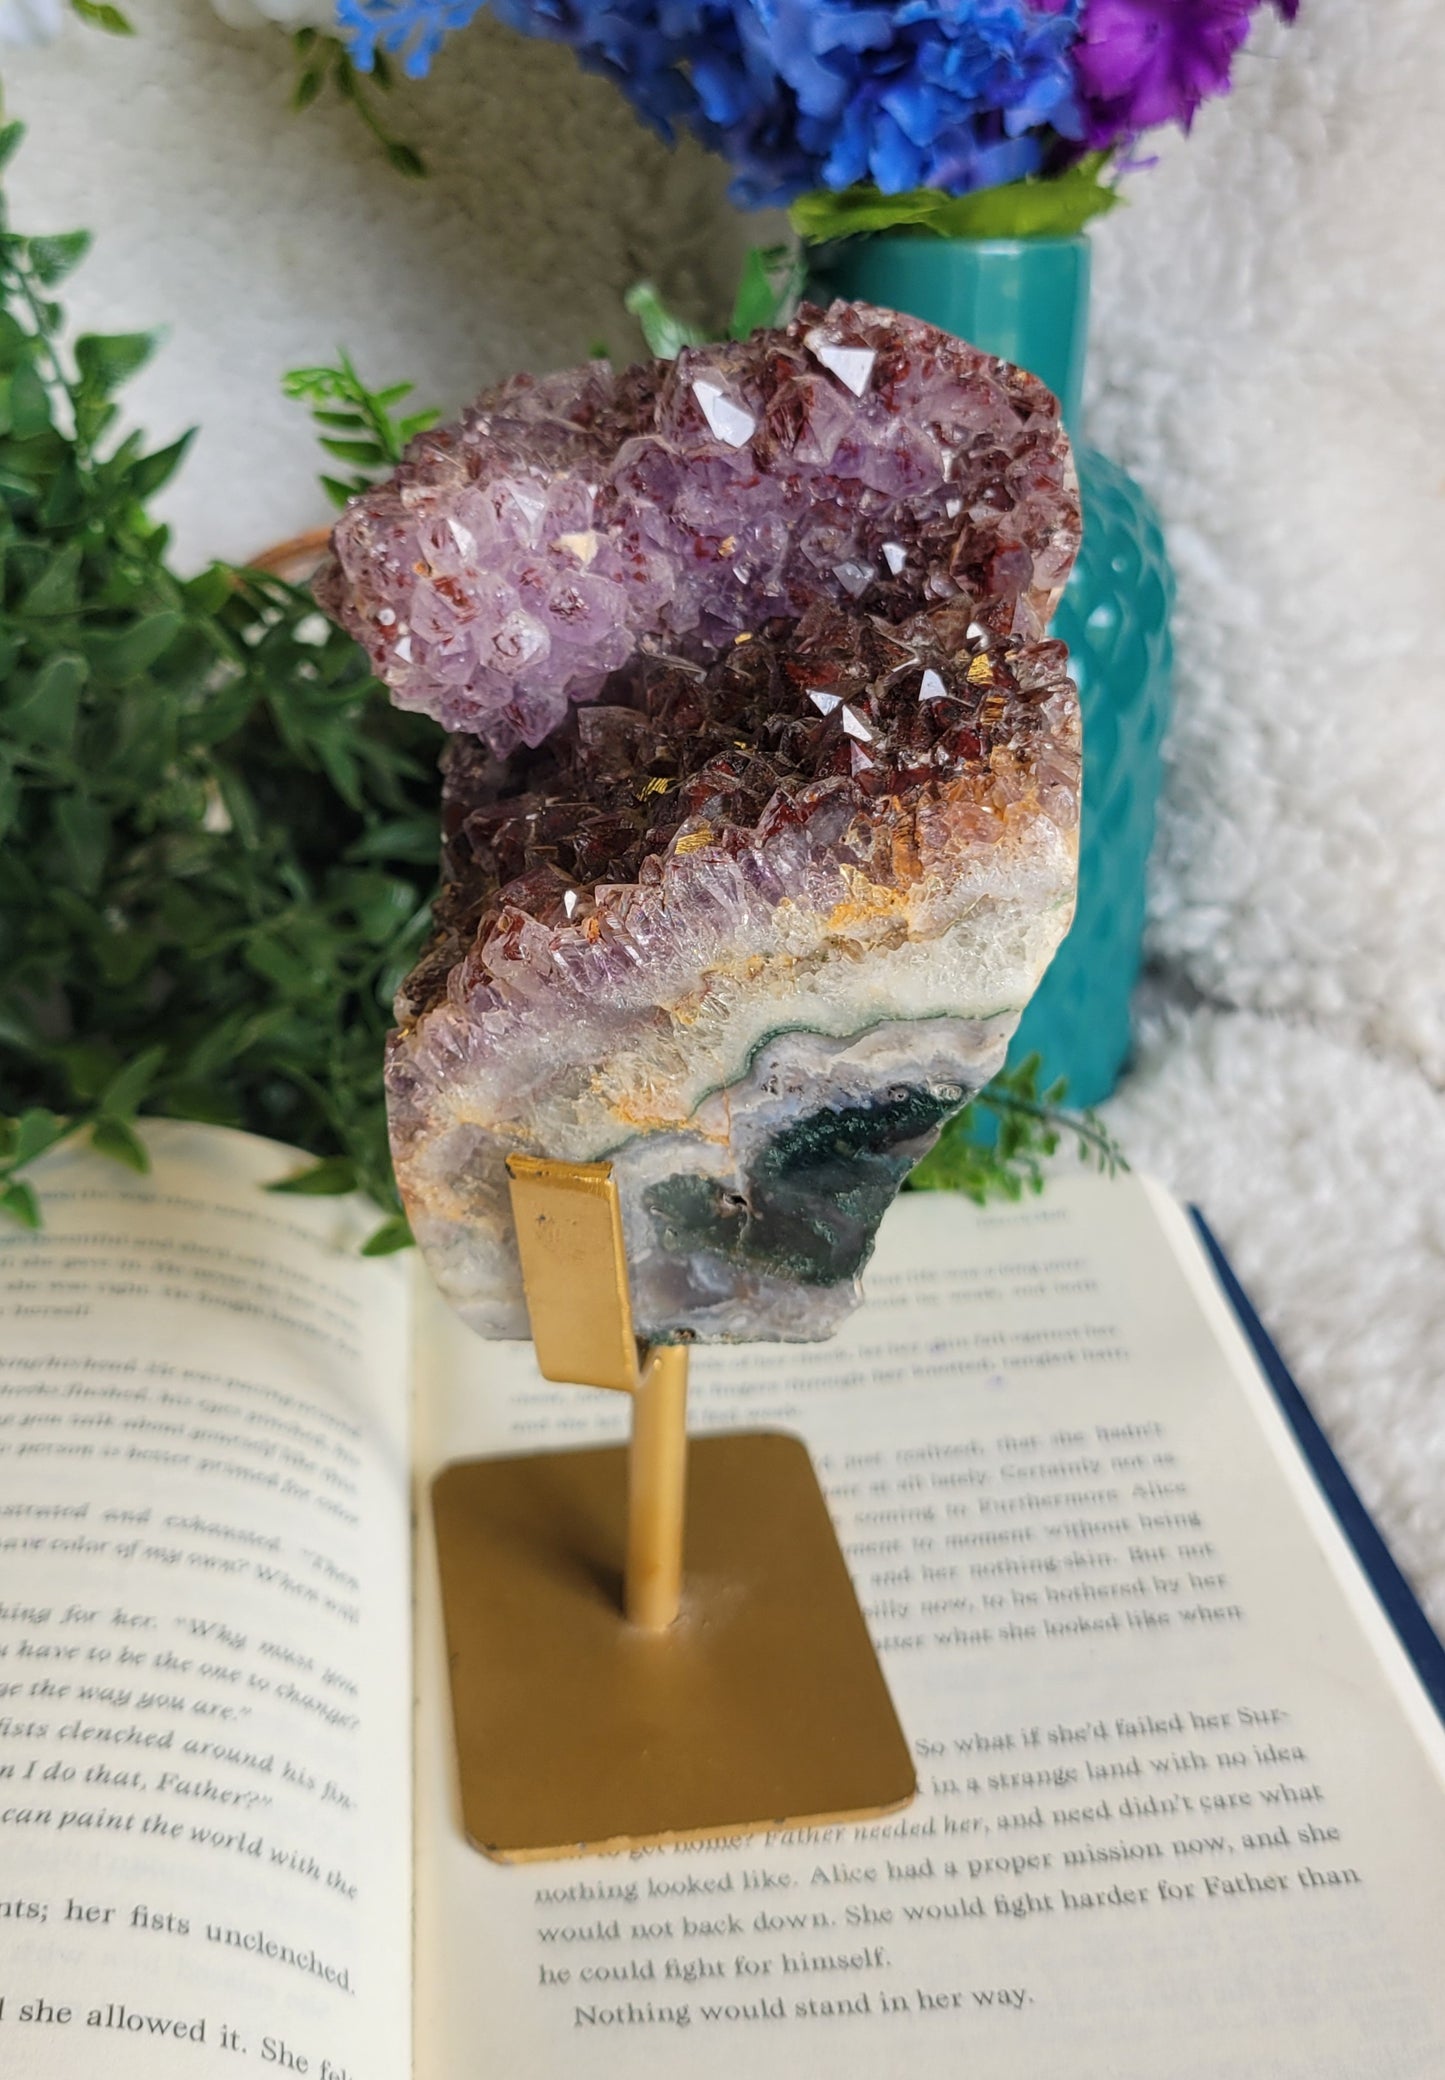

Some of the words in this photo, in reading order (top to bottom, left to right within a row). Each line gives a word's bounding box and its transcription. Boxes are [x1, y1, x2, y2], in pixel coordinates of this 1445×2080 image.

[912, 1536, 933, 1550] to
[946, 1528, 1032, 1547] moment
[1043, 1518, 1130, 1540] without
[1137, 1512, 1201, 1531] being
[872, 1566, 910, 1586] and
[921, 1564, 958, 1581] her
[1129, 1546, 1165, 1563] But
[1178, 1542, 1214, 1559] not
[921, 1600, 974, 1615] now,
[982, 1594, 1003, 1609] to
[1010, 1588, 1037, 1606] be
[1045, 1578, 1145, 1602] bothered
[1152, 1576, 1179, 1596] by
[1188, 1572, 1226, 1590] her
[934, 1626, 992, 1645] what
[999, 1621, 1037, 1640] she
[1043, 1614, 1119, 1636] looked
[1126, 1610, 1170, 1630] like
[1178, 1604, 1243, 1624] when
[16, 1639, 80, 1660] have
[87, 1645, 112, 1662] to
[118, 1645, 146, 1665] be
[153, 1650, 192, 1673] the
[200, 1662, 243, 1683] one
[249, 1671, 271, 1691] to
[274, 1678, 361, 1732] change?
[29, 1678, 71, 1698] the
[79, 1685, 131, 1706] way
[135, 1691, 185, 1709] you
[192, 1698, 253, 1721] are."
[57, 1721, 174, 1750] clenched
[182, 1735, 274, 1773] around
[282, 1760, 317, 1789] his
[916, 1735, 944, 1757] So
[954, 1730, 1016, 1753] what
[1023, 1725, 1040, 1748] if
[1048, 1720, 1107, 1745] she'd
[1116, 1713, 1183, 1739] failed
[1192, 1710, 1231, 1732] her
[1237, 1705, 1289, 1727] Sur-
[21, 1760, 38, 1779] I
[43, 1760, 76, 1781] do
[85, 1765, 146, 1791] that,
[156, 1771, 273, 1809] Father?"
[932, 1772, 959, 1794] in
[966, 1775, 980, 1790] a
[987, 1768, 1078, 1789] strange
[1086, 1755, 1141, 1781] land
[1150, 1750, 1208, 1774] with
[1216, 1752, 1246, 1769] no
[1253, 1742, 1306, 1765] idea
[854, 1816, 936, 1840] needed
[943, 1812, 990, 1837] her,
[997, 1805, 1041, 1829] and
[1052, 1800, 1113, 1825] need
[1119, 1793, 1193, 1819] didn't
[1200, 1792, 1252, 1811] care
[1258, 1780, 1324, 1805] what
[2, 1807, 52, 1824] can
[57, 1809, 134, 1830] paint
[141, 1815, 182, 1838] the
[190, 1824, 263, 1858] world
[270, 1847, 320, 1879] with
[325, 1871, 358, 1901] the
[535, 1878, 638, 1904] nothing
[648, 1866, 734, 1893] looked
[742, 1864, 798, 1888] like.
[810, 1860, 877, 1884] Alice
[887, 1854, 933, 1878] had
[944, 1859, 958, 1875] a
[969, 1852, 1052, 1880] proper
[1063, 1839, 1162, 1865] mission
[1172, 1836, 1234, 1861] now,
[1242, 1825, 1290, 1851] and
[1298, 1821, 1341, 1845] she
[538, 1916, 620, 1943] would
[630, 1917, 673, 1938] not
[683, 1910, 744, 1936] back
[753, 1909, 836, 1932] down.
[846, 1901, 892, 1925] She
[904, 1893, 983, 1921] would
[994, 1888, 1053, 1920] fight
[1061, 1882, 1148, 1909] harder
[1158, 1877, 1194, 1900] for
[1203, 1869, 1289, 1895] Father
[1298, 1863, 1361, 1888] than
[64, 1898, 116, 1924] her
[131, 1906, 190, 1935] fists
[205, 1922, 356, 1996] unclenched.
[539, 1962, 570, 1986] he
[580, 1956, 655, 1983] could
[665, 1954, 726, 1985] fight
[734, 1952, 772, 1975] for
[782, 1942, 892, 1971] himself.
[574, 1998, 690, 2028] Nothing
[701, 1992, 784, 2019] would
[795, 1988, 870, 2016] stand
[881, 1987, 910, 2011] in
[918, 1984, 962, 2008] her
[971, 1986, 1035, 2010] way.
[19, 1999, 72, 2024] she
[86, 2004, 206, 2043] allowed
[220, 2025, 248, 2053] it.
[261, 2037, 308, 2073] She
